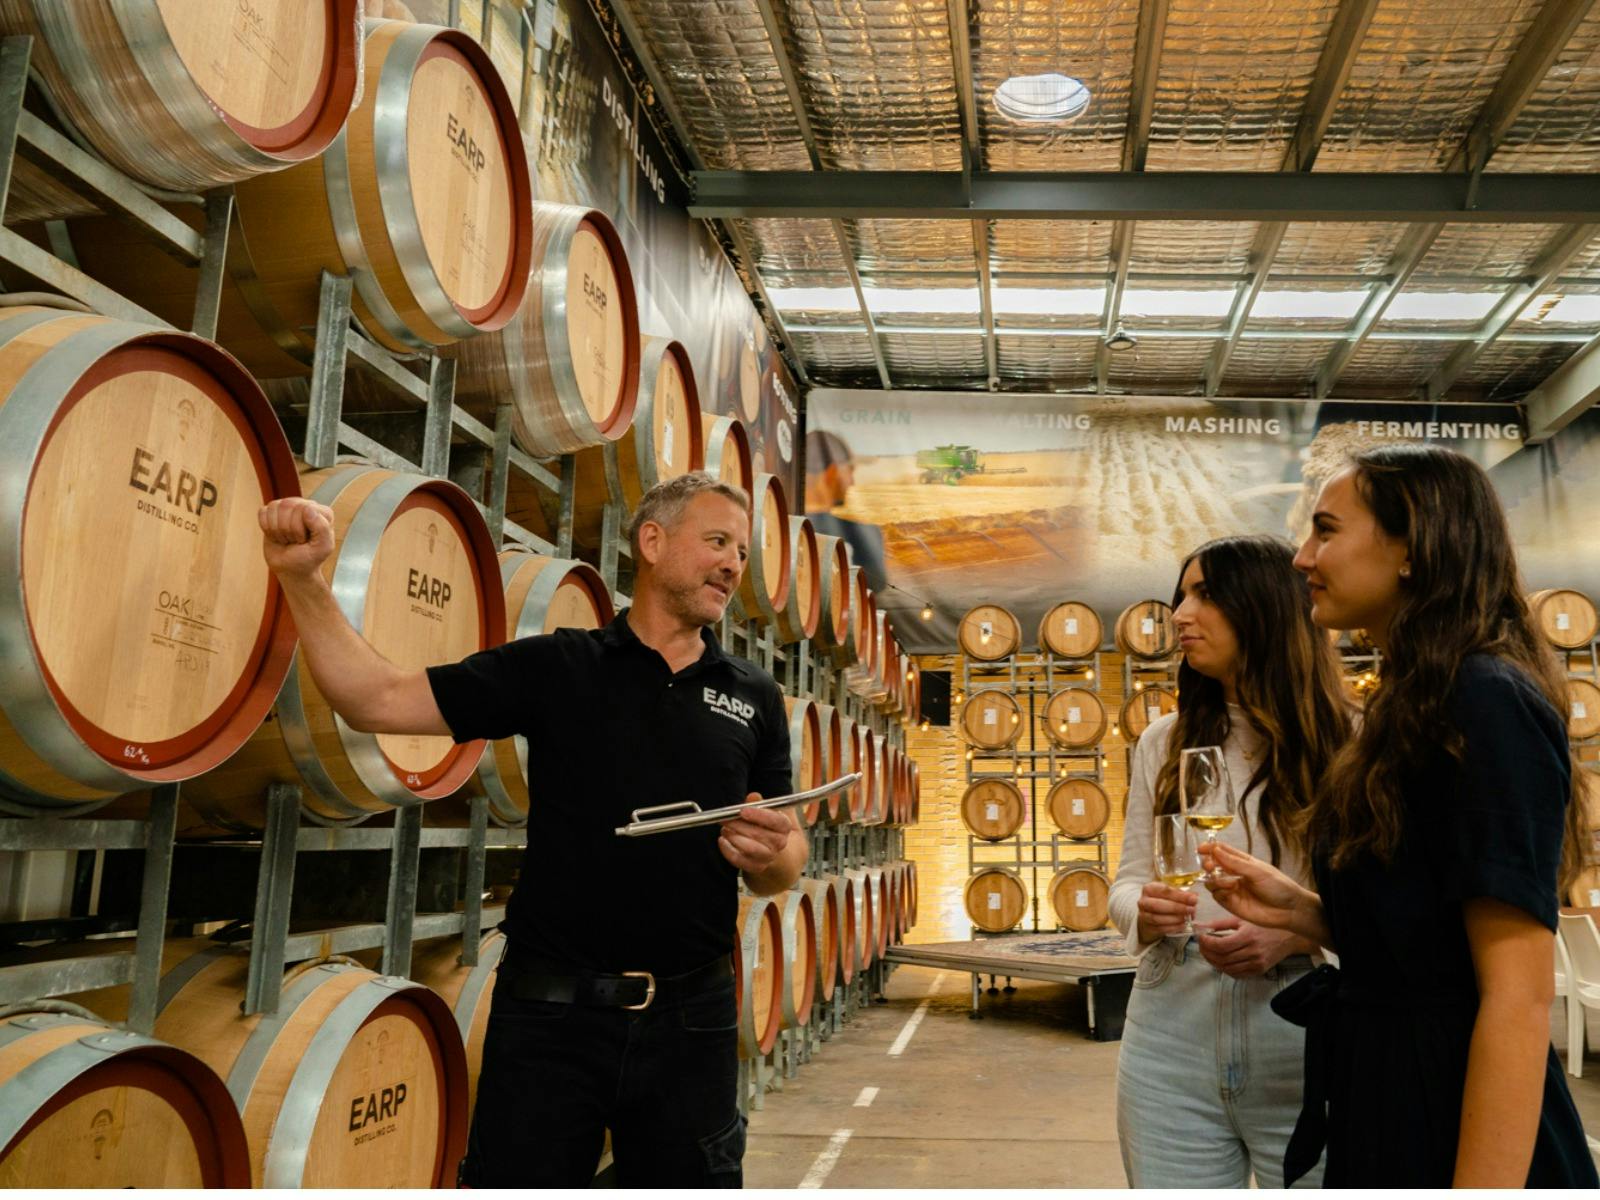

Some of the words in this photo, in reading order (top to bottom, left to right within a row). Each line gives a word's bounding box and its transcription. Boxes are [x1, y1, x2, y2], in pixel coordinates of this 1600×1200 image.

[447, 112, 485, 172] EARP
[603, 76, 665, 204] DISTILLING
[584, 272, 607, 311] EARP
[839, 407, 912, 425] GRAIN
[992, 413, 1092, 431] ALTING
[1165, 416, 1281, 435] MASHING
[1357, 420, 1520, 440] FERMENTING
[129, 446, 218, 517] EARP
[137, 499, 184, 528] DISTILLING
[159, 590, 191, 616] OAK
[407, 567, 451, 609] EARP
[703, 686, 755, 719] EARP
[349, 1083, 407, 1133] EARP
[354, 1127, 386, 1146] DISTILLING
